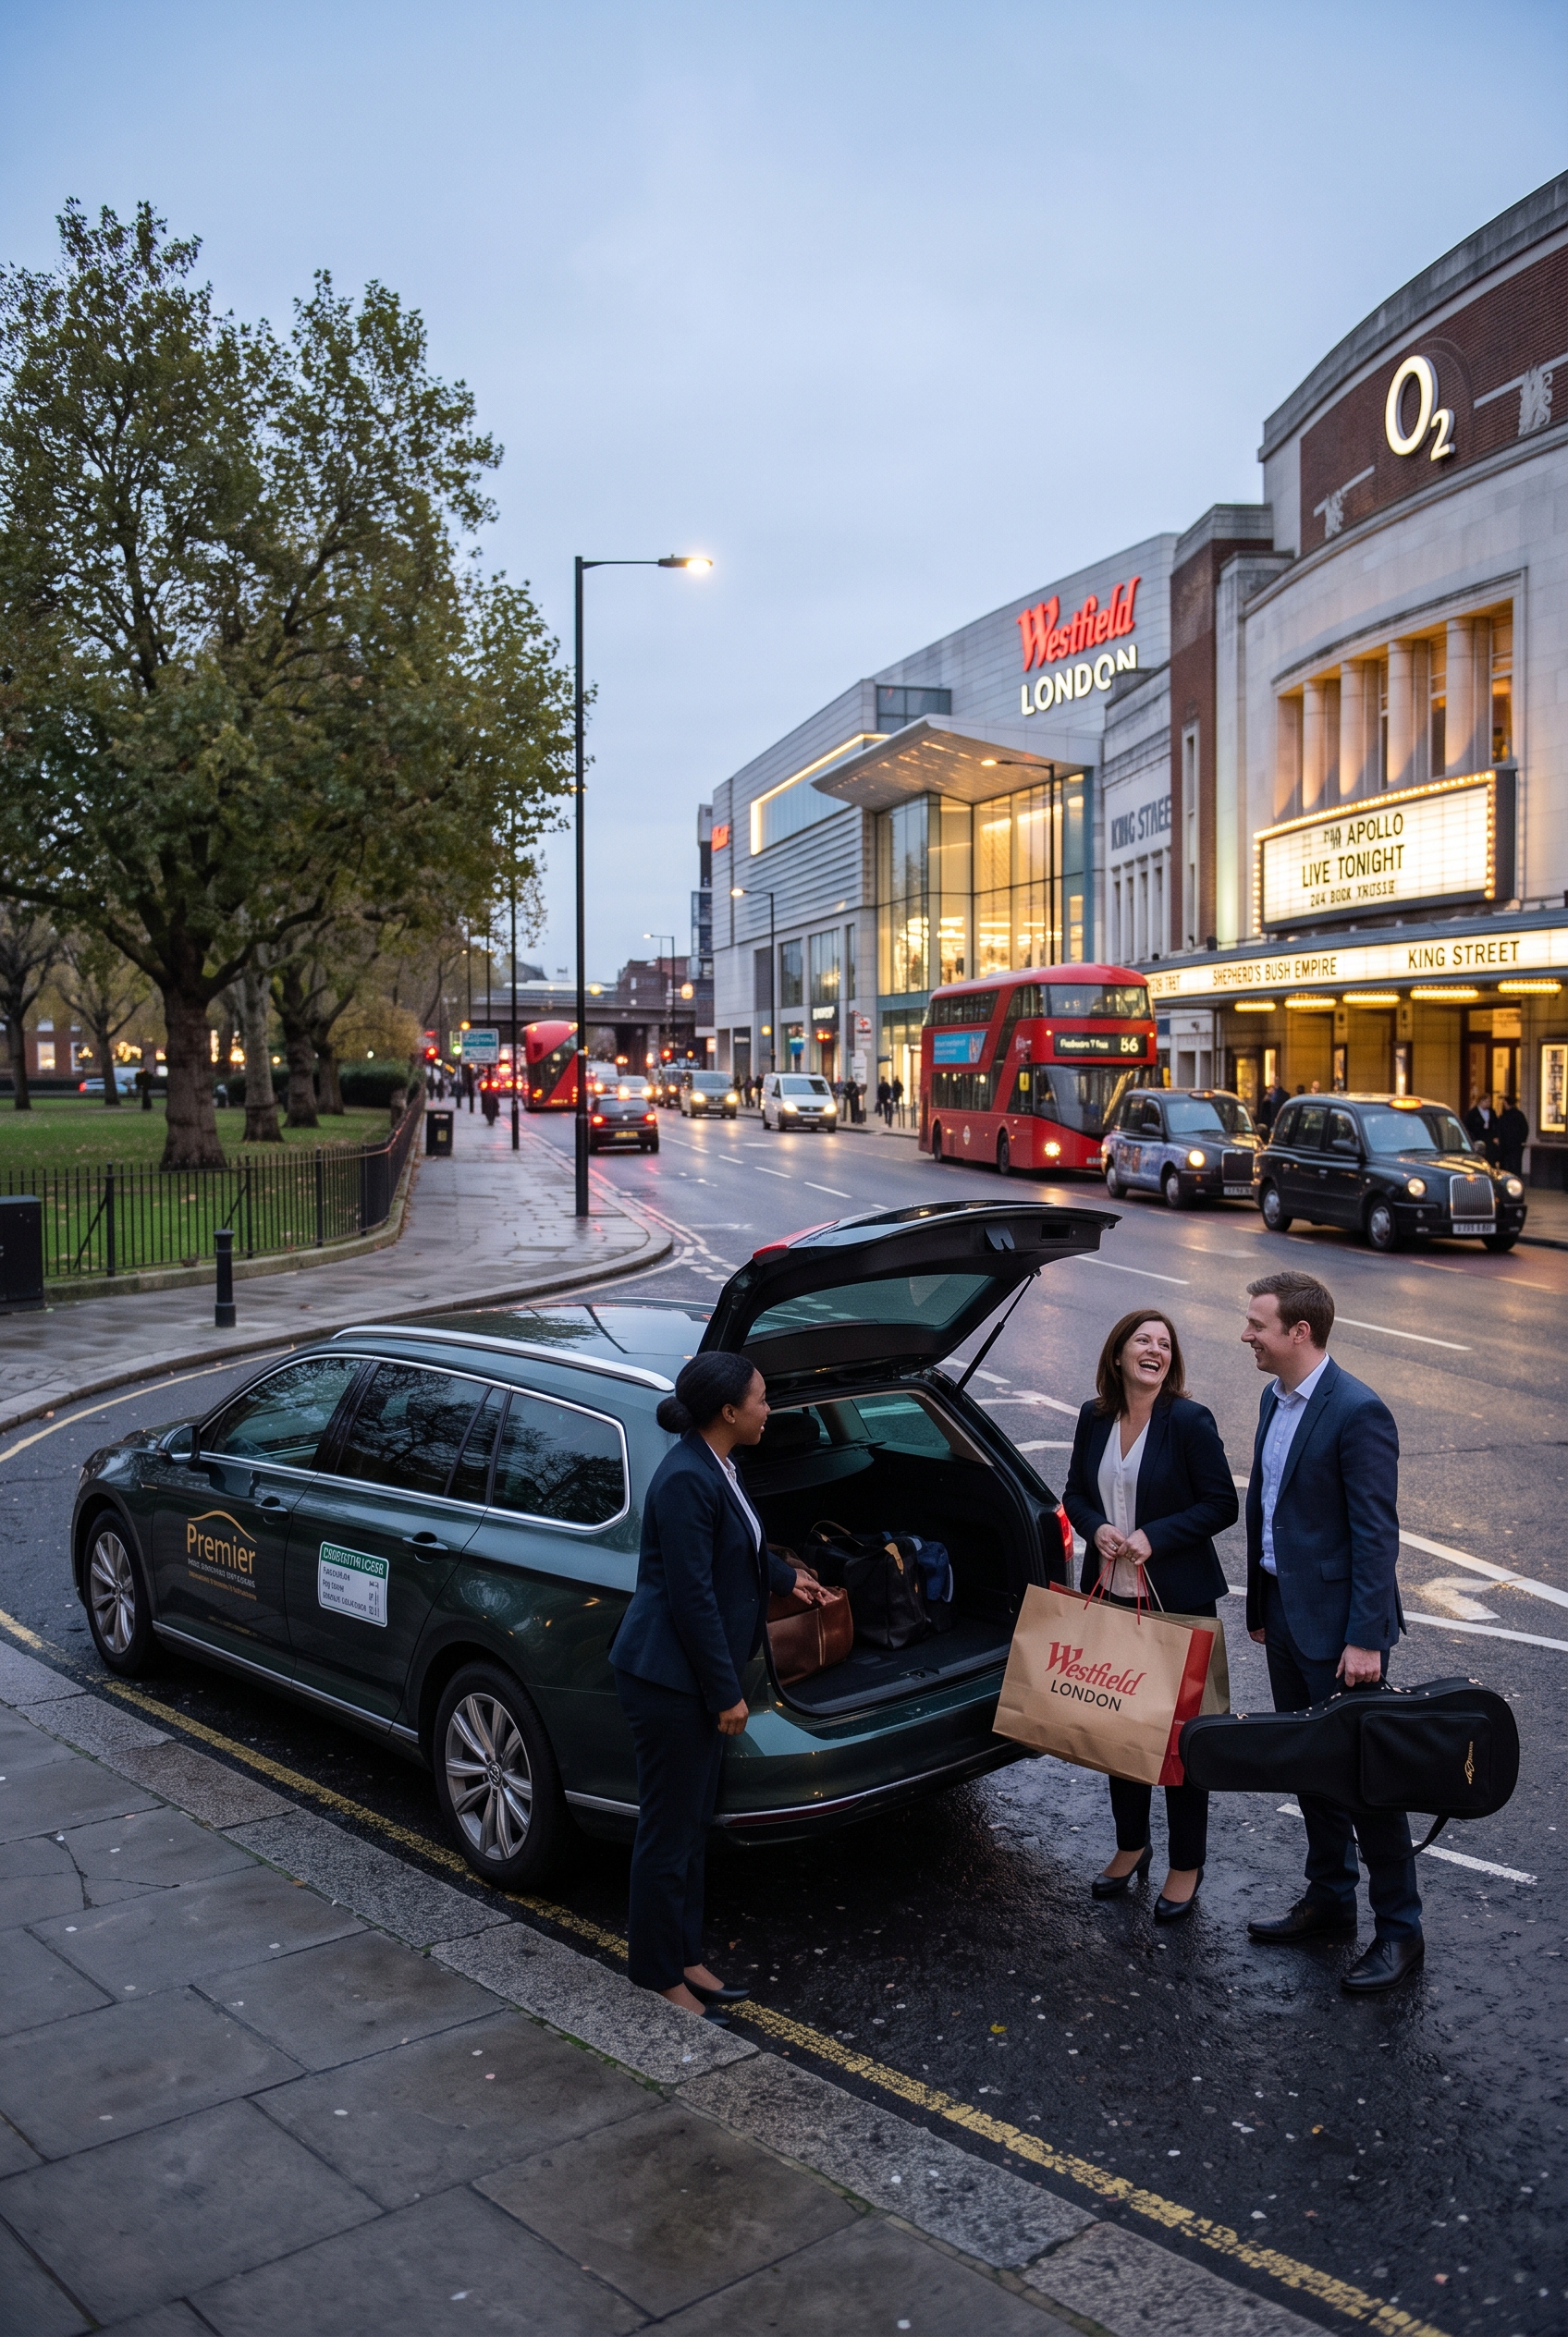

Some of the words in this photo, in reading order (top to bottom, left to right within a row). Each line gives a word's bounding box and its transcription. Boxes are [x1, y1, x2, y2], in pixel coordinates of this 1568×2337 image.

[1385, 355, 1455, 461] O2
[1016, 575, 1141, 672] Westfield
[1021, 644, 1137, 716] LONDON
[1138, 794, 1171, 840] STREE
[1347, 813, 1403, 846] APOLLO
[1303, 860, 1330, 887] LIVE
[1338, 844, 1404, 879] TONIGHT
[1213, 964, 1261, 986] SHEPHERD'S
[1265, 962, 1291, 981] BUSH
[1295, 957, 1337, 978] EMPIRE
[1408, 947, 1446, 970] KING
[1452, 941, 1520, 965] STREET
[187, 1523, 256, 1574] Premier
[1045, 1641, 1147, 1695] Westfield
[1050, 1680, 1121, 1711] LONDON
